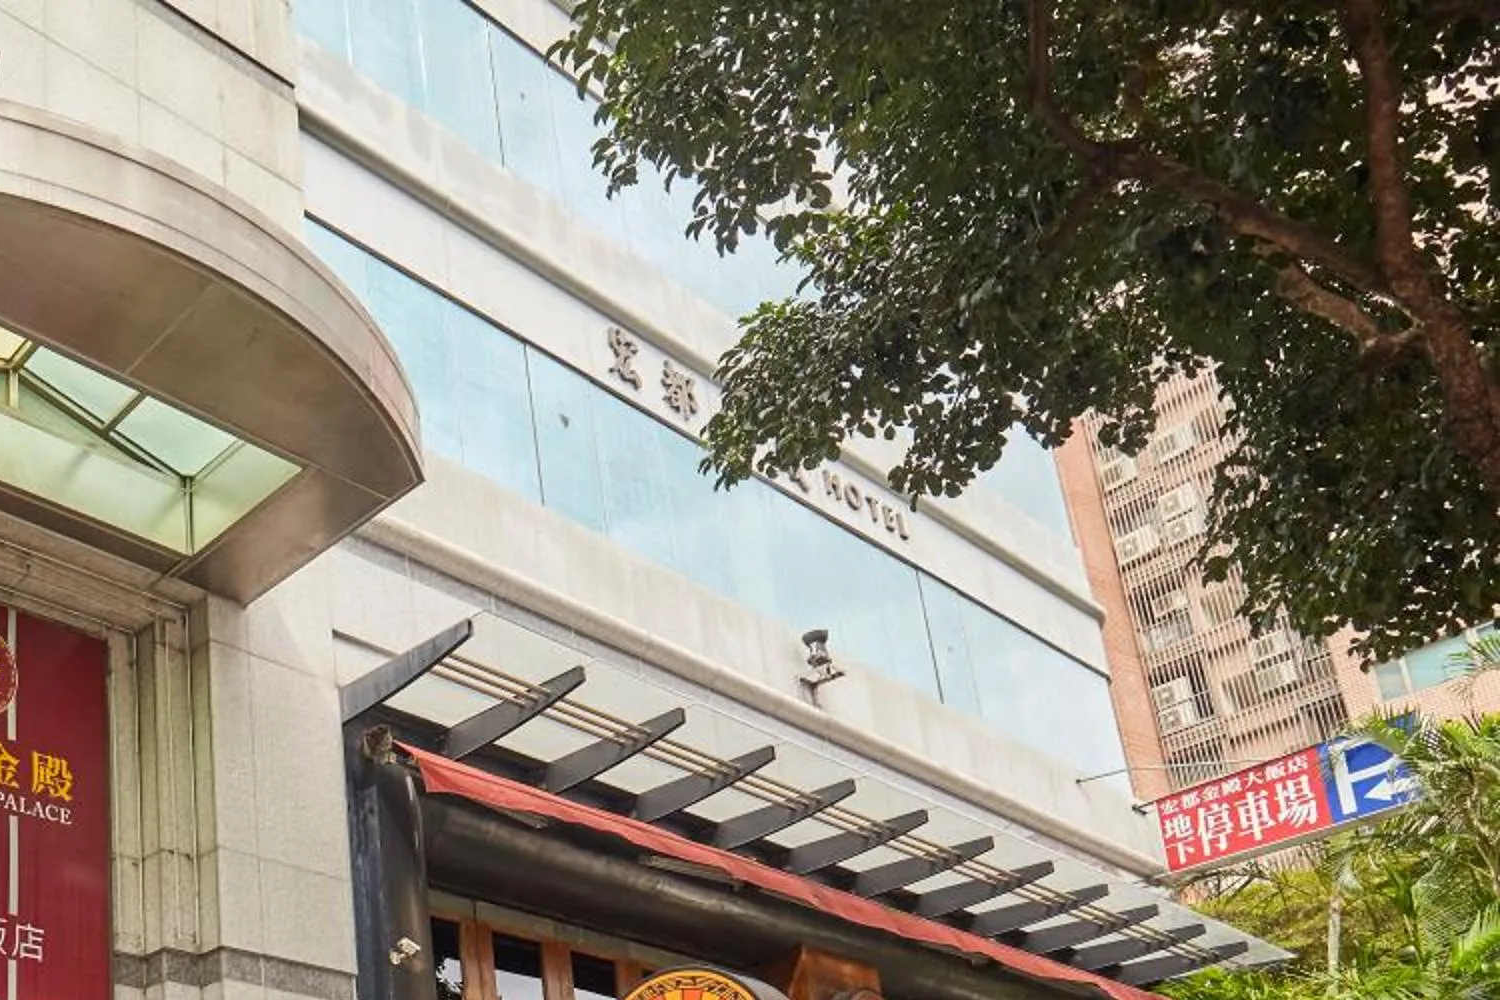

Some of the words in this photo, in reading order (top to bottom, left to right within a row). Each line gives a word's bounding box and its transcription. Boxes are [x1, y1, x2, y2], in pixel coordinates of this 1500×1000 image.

[820, 469, 910, 541] HOTEL
[1158, 754, 1311, 816] 宏都金殿大飯店
[1197, 775, 1319, 857] 停車場
